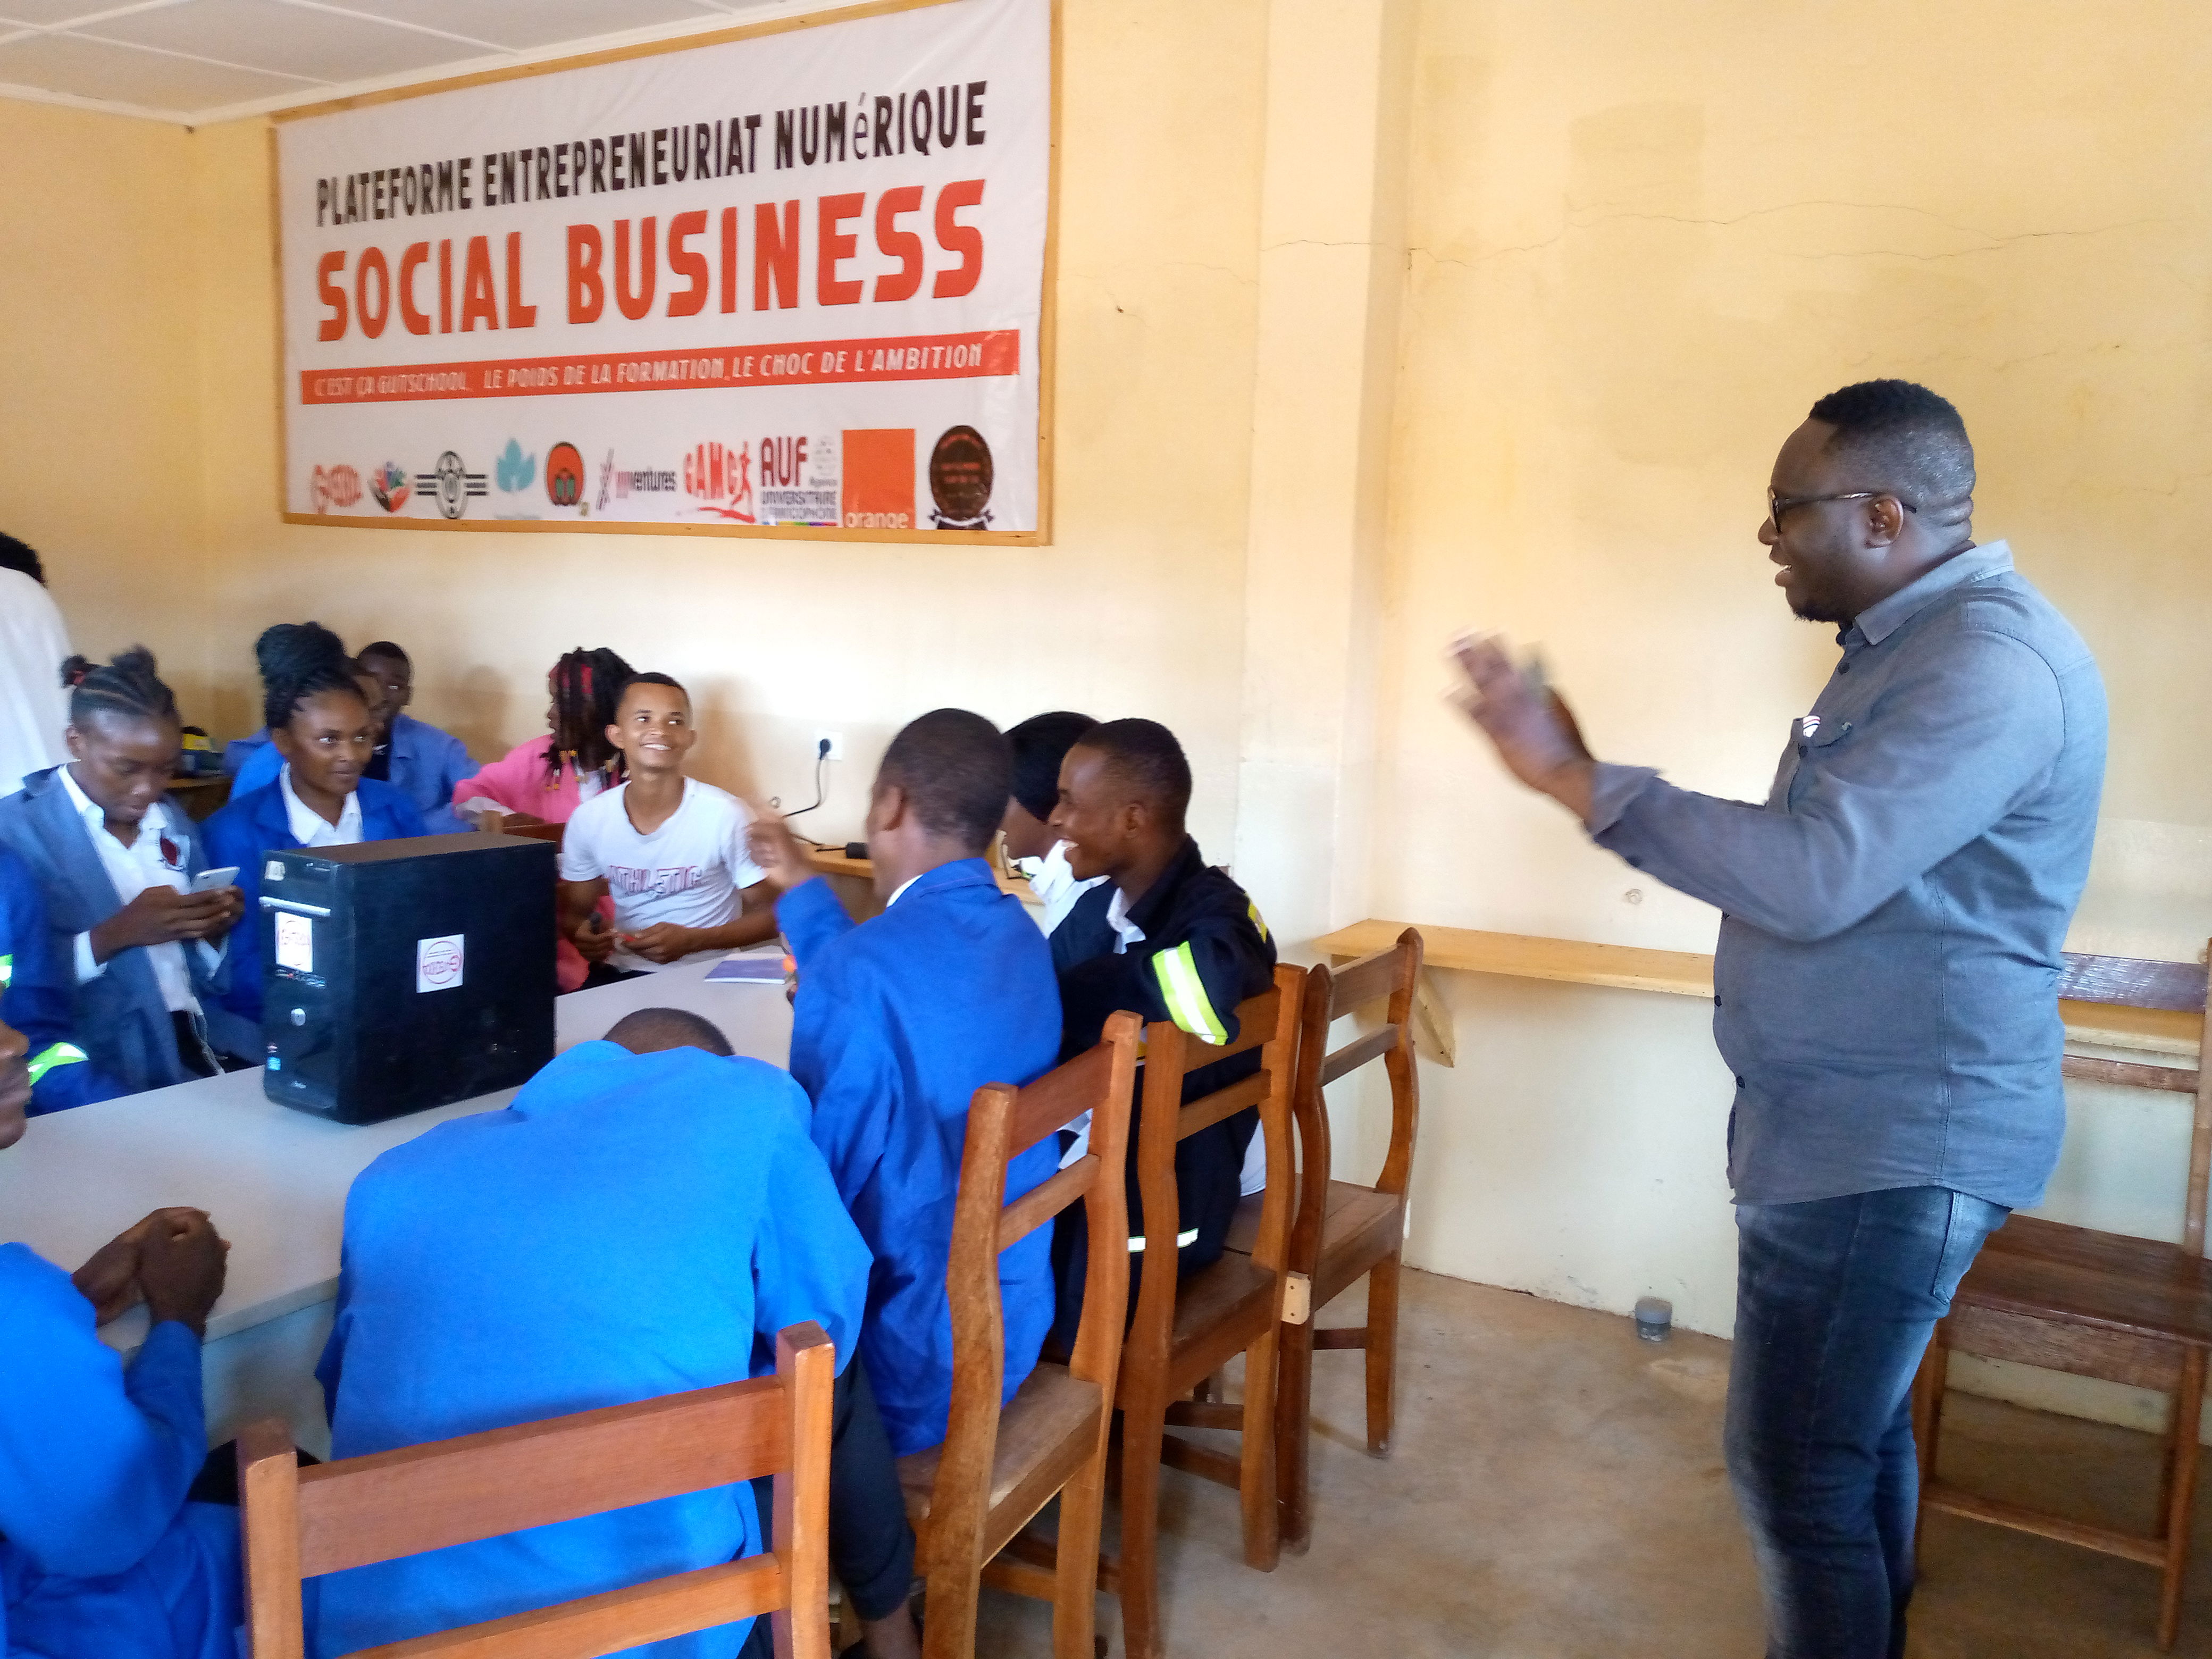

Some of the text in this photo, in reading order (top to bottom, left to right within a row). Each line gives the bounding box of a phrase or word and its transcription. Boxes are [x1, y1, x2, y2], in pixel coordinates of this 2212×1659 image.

[316, 157, 473, 227] PLATEFORME
[482, 114, 761, 207] ENTREPRENEURIAT
[317, 179, 986, 342] SOCIAL BUSINESS
[484, 369, 502, 389] LE
[507, 365, 559, 387] POIDS
[564, 365, 586, 386] DE
[591, 364, 611, 384] LA
[732, 356, 755, 378] LE
[760, 352, 815, 376] CHOC
[820, 350, 848, 373] DE
[854, 343, 983, 372] L'AMBITION
[761, 436, 808, 487] AUF
